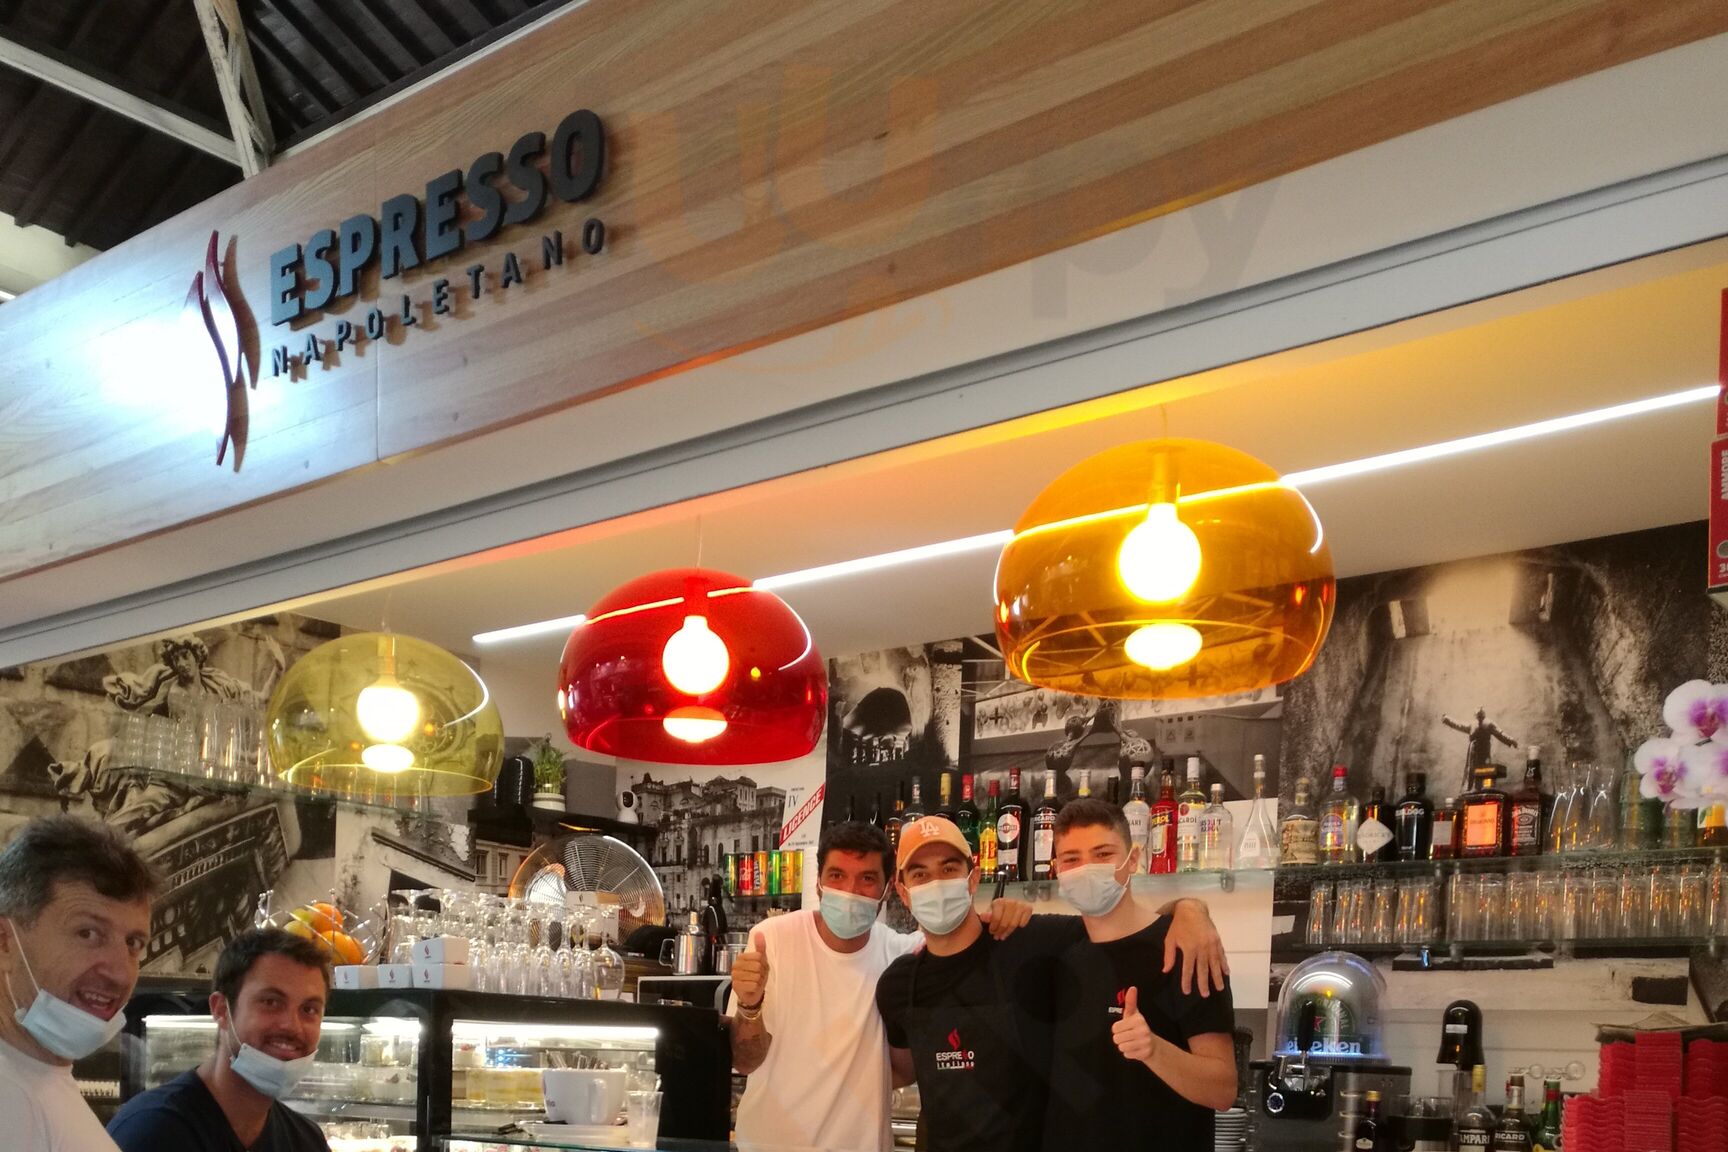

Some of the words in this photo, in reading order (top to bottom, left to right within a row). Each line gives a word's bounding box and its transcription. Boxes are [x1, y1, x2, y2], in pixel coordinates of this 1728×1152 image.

[270, 108, 606, 326] ESPRESSO
[272, 217, 606, 377] NAPOLETANO
[783, 787, 824, 840] LICENCE
[919, 820, 940, 837] LA
[1287, 1036, 1361, 1054] eieken
[936, 1050, 975, 1061] ESPREO
[1459, 1134, 1490, 1145] AMPARI
